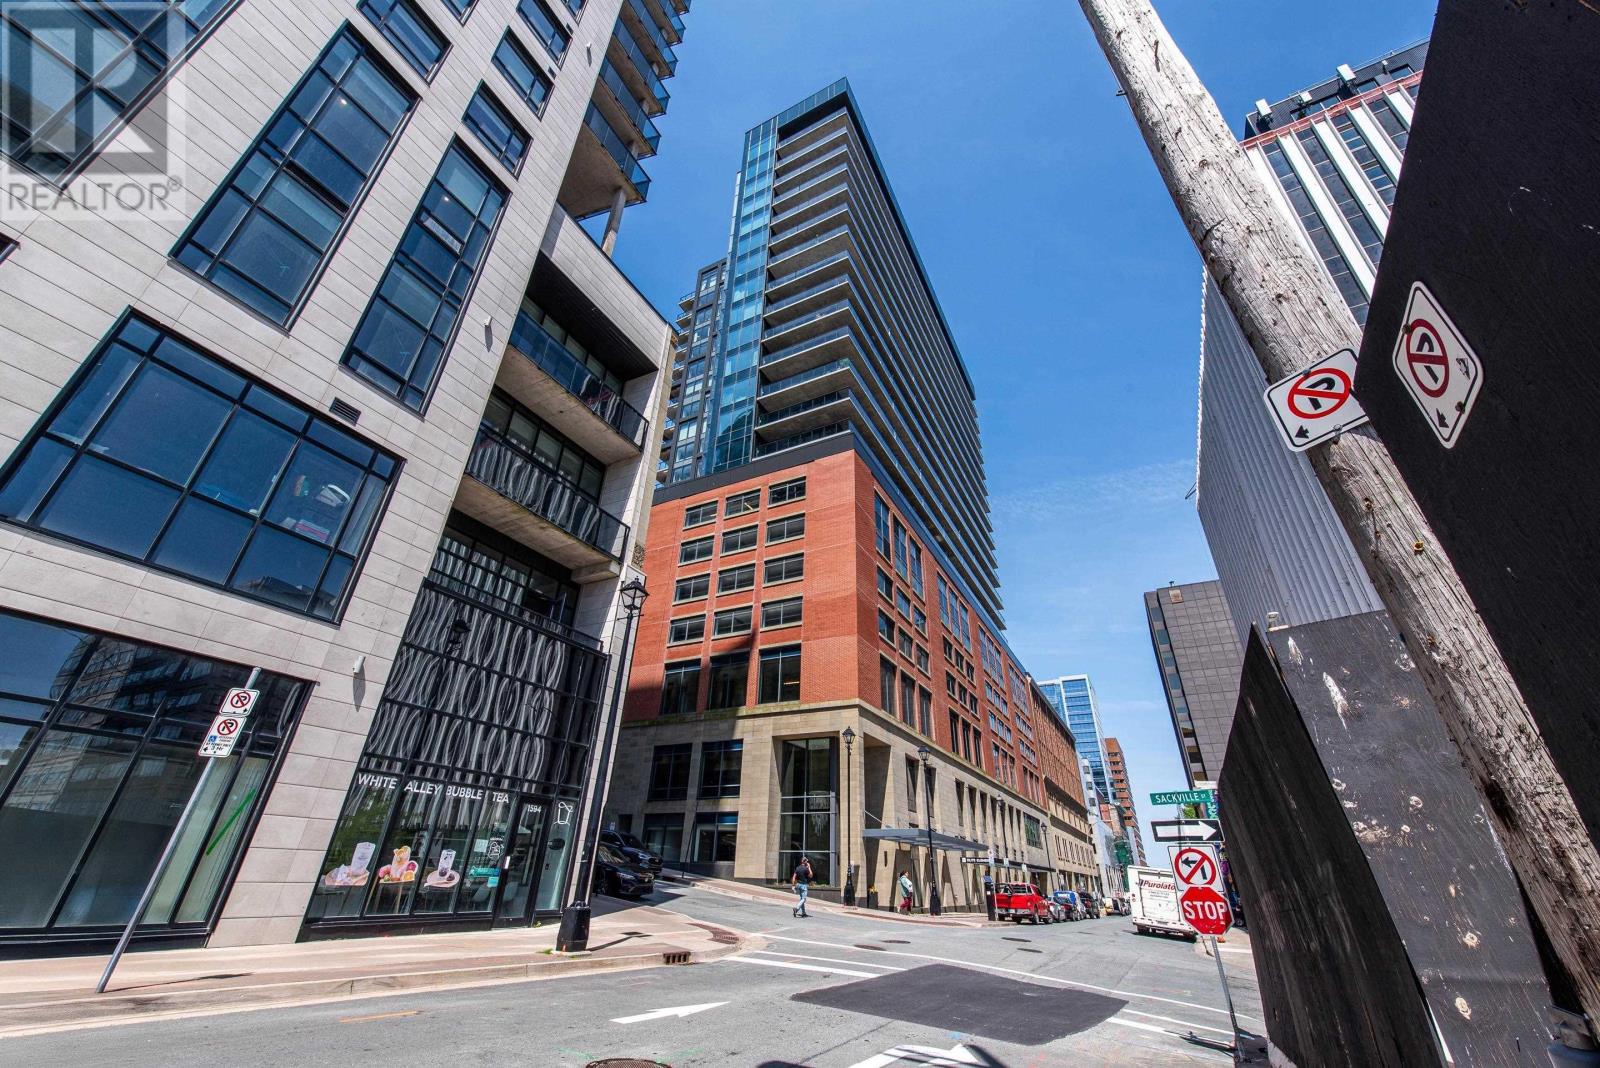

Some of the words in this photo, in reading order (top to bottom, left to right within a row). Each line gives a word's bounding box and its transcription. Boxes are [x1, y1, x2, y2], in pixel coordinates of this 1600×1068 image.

[358, 773, 398, 789] WHITE
[404, 780, 443, 795] ALLEY
[446, 785, 484, 800] BUBBLE
[492, 791, 509, 804] TEA
[1155, 793, 1200, 804] SACKVILLE
[527, 804, 542, 813] 1594
[1143, 880, 1175, 890] Purolato
[1182, 900, 1227, 921] STOP
